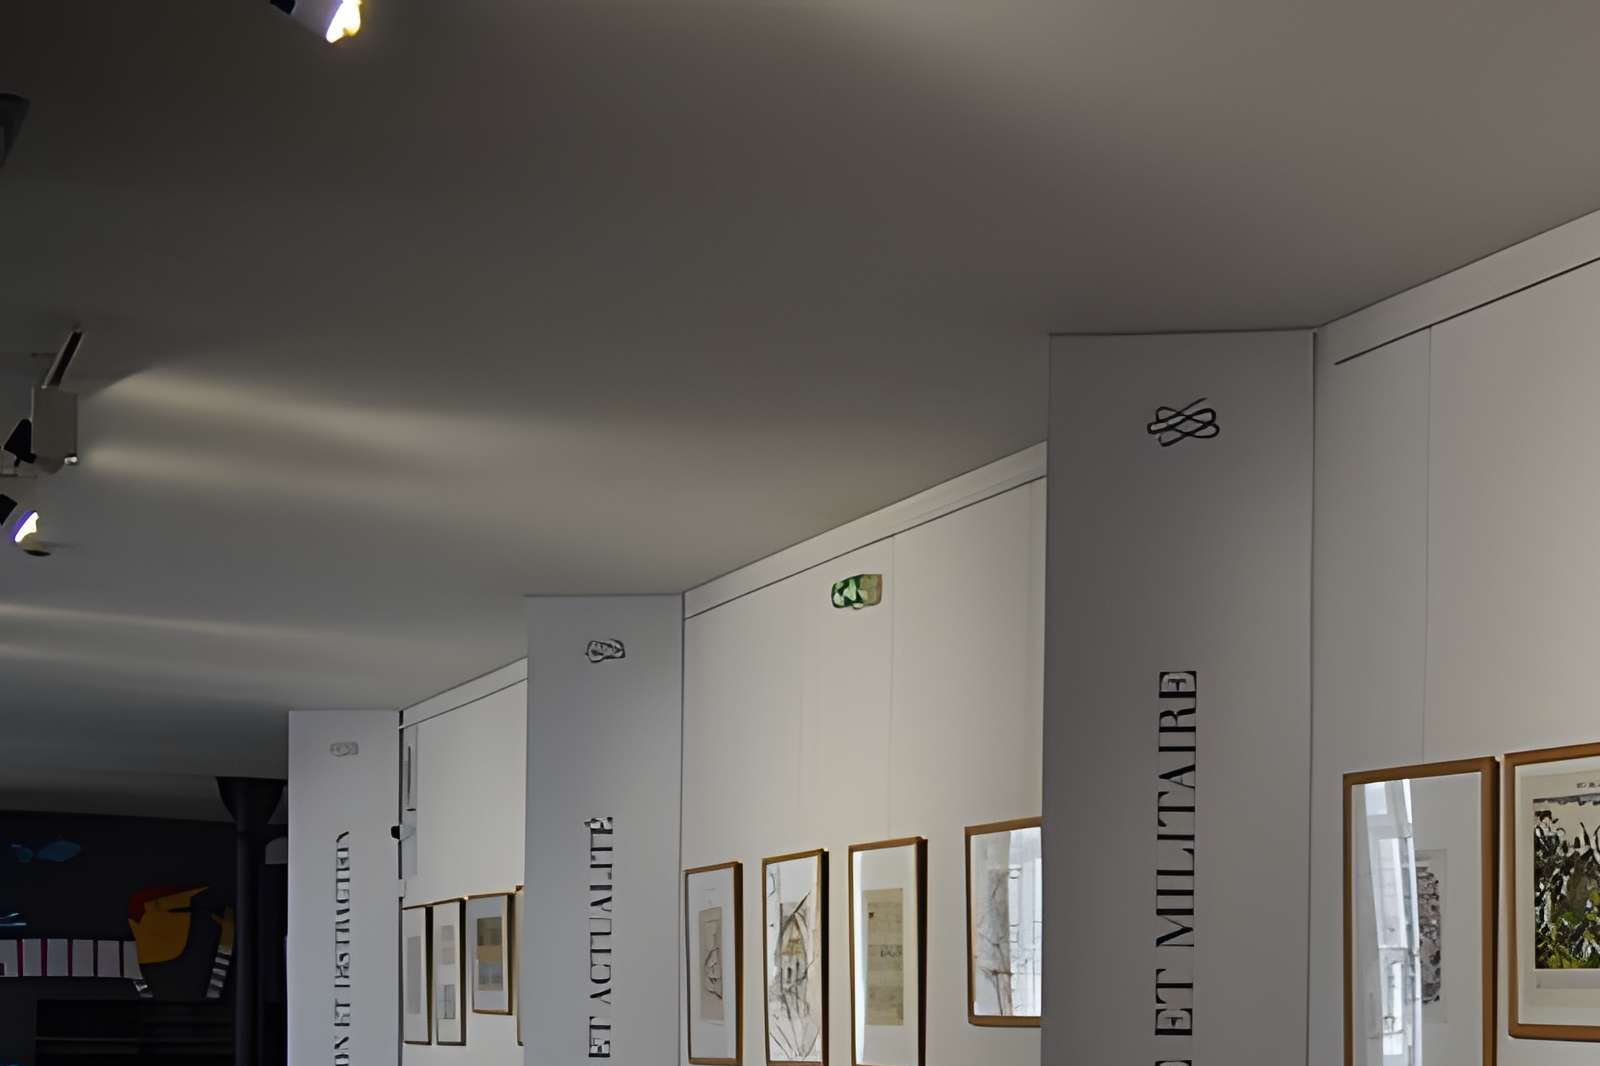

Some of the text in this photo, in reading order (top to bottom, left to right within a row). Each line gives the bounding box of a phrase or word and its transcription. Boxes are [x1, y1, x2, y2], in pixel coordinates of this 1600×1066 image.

[1156, 671, 1197, 948] MILITAIRE
[584, 815, 613, 1005] ACTUALITÉ
[588, 1015, 611, 1059] ET
[1154, 968, 1194, 1037] ET
